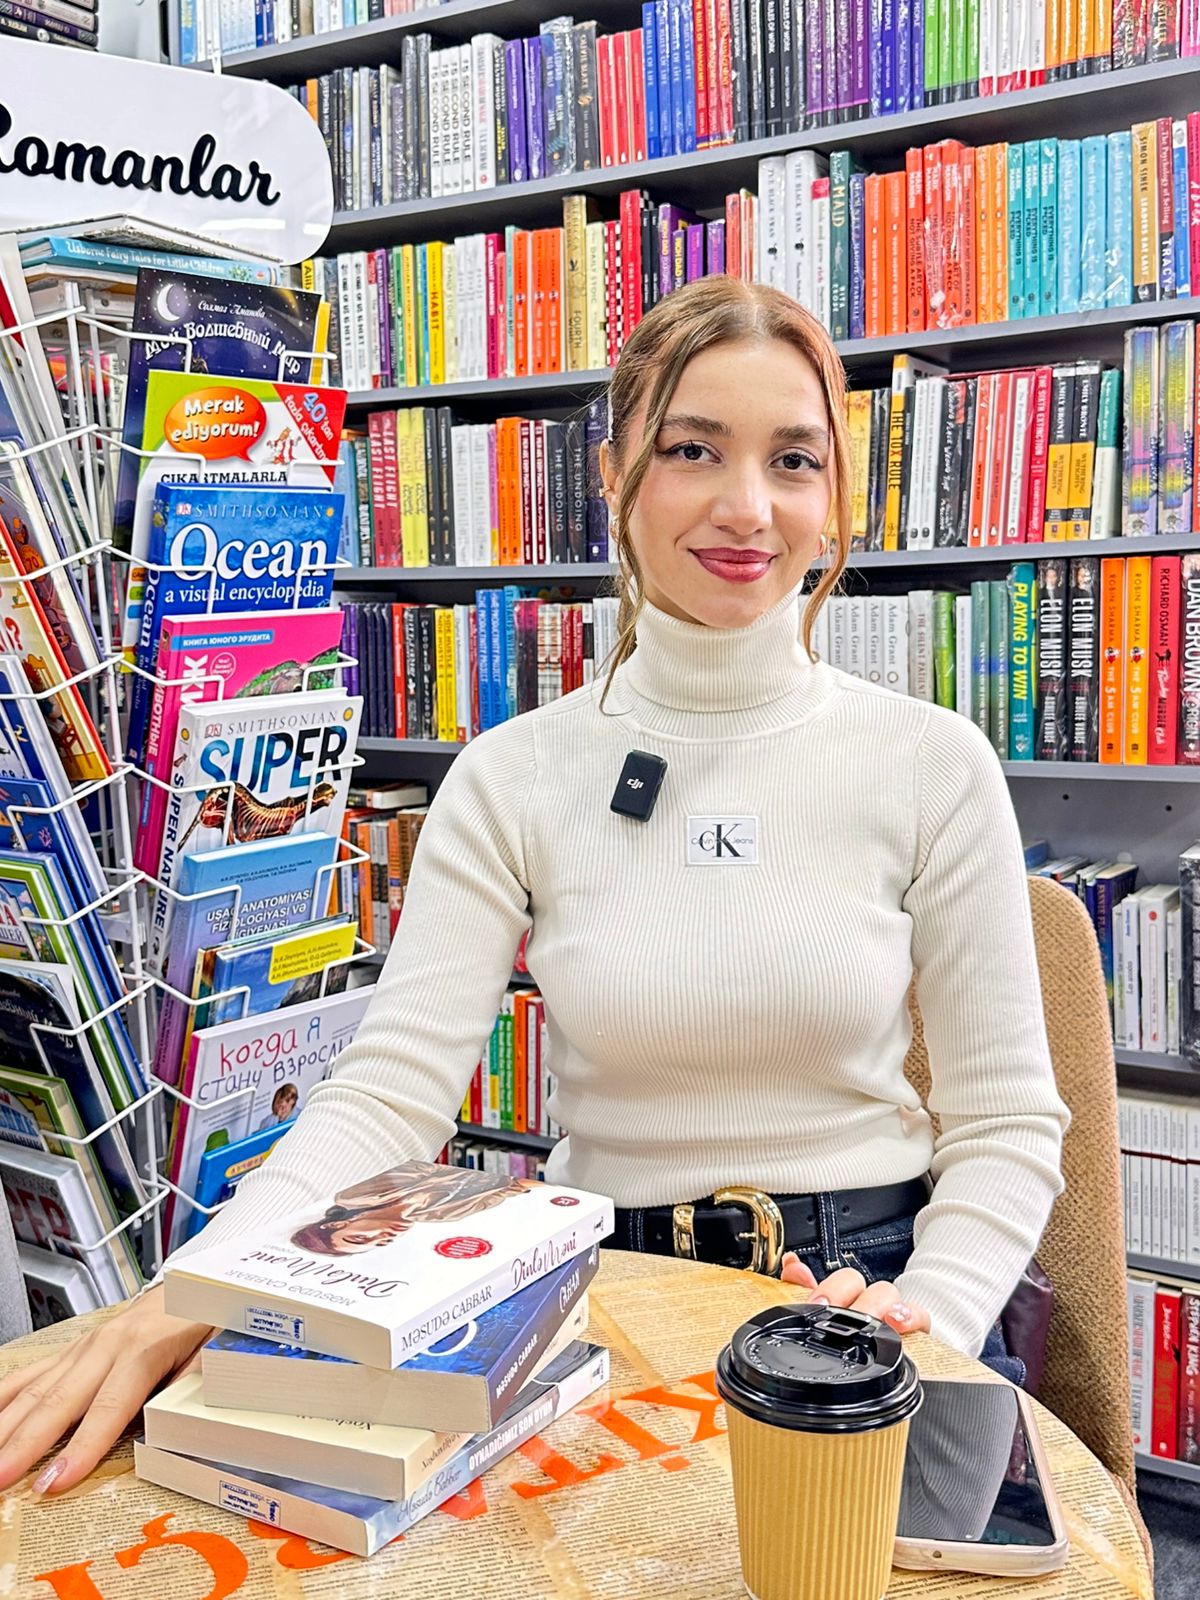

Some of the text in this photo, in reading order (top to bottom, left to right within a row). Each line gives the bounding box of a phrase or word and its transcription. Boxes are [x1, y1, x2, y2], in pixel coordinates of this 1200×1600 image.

[1139, 136, 1147, 165] SIMON
[1160, 146, 1168, 187] Psychology
[1140, 168, 1148, 192] SINEK
[832, 186, 844, 228] MAID
[1162, 198, 1170, 224] Selling
[1162, 239, 1172, 284] TRACY
[430, 291, 440, 330] HABIT
[184, 321, 271, 348] Волшебный
[184, 395, 245, 417] Merak
[1058, 381, 1067, 406] EMILY
[1081, 379, 1090, 404] EMILY
[171, 421, 260, 442] ediyorum!
[1035, 374, 1047, 456] THE SIXTH EXTINCTION
[370, 432, 386, 509] LAST FLIGHT
[383, 431, 398, 508] LAST FLIGHT
[888, 410, 904, 490] THE 10X RULE
[554, 449, 564, 532] THE UNDOING
[574, 447, 583, 532] THE UNDOING
[1056, 454, 1064, 495] WUTHERING
[195, 503, 324, 519] SMITHSONIAN
[170, 522, 328, 581] Ocean
[165, 580, 325, 605] a visual encyclopedia
[1109, 574, 1117, 601] ROBIN
[1134, 573, 1142, 601] ROBIN
[183, 632, 271, 648] КНИГА ЮНОГО ЭРУДИТА
[833, 603, 843, 664] Adam Grant
[851, 603, 860, 664] Adam Grant
[870, 603, 880, 664] Adam Grant
[888, 603, 898, 664] Adam Grant
[1013, 582, 1028, 700] PLAYING TO WIN
[1133, 605, 1141, 642] SHARMA
[1159, 612, 1169, 647] OSMAN
[1184, 579, 1200, 693] DAN BROWN
[917, 613, 926, 695] THE SILENT PATIENT
[1040, 599, 1063, 743] ELON MUSK ASHLEE VANCE
[1071, 598, 1094, 744] ELON MUSK ASHLEE VANCE
[1107, 666, 1115, 682] THE
[1132, 666, 1141, 682] THE
[227, 710, 338, 736] SMITHSONIAN
[1106, 713, 1115, 734] CLUB
[1131, 713, 1140, 734] CLUB
[196, 725, 348, 803] SUPER
[153, 773, 185, 929] SUPER NATURE
[292, 903, 306, 914] VƏ
[224, 1269, 288, 1293] CABBAR
[401, 1306, 451, 1351] MƏSUDƏ
[451, 1285, 494, 1321] CABBAR
[496, 1333, 538, 1399] MƏSUDƏ CABBAR
[1186, 1343, 1198, 1376] KING
[468, 1425, 519, 1471] OYNADIĞIMIZ
[518, 1415, 535, 1436] SON
[534, 1398, 554, 1424] OYUN
